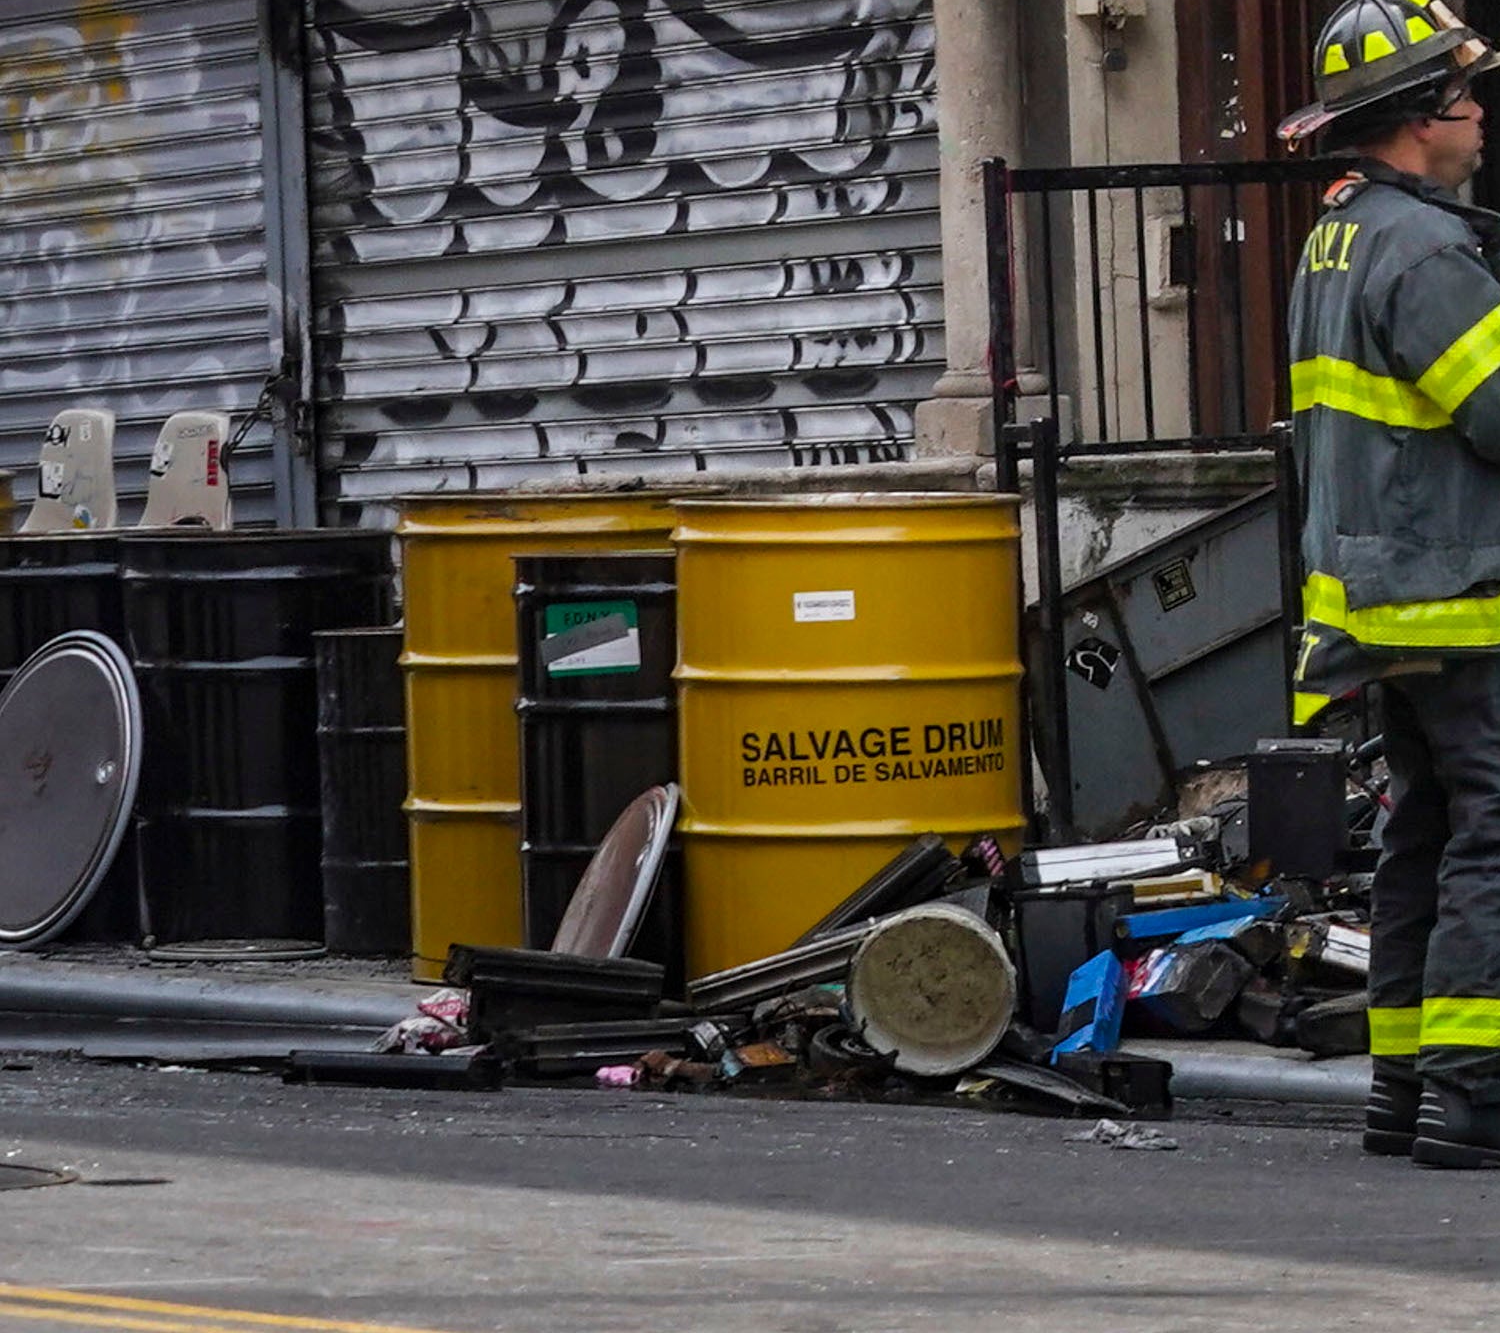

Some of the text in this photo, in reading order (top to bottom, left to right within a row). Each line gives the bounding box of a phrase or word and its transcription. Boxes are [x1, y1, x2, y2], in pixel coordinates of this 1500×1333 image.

[741, 717, 1004, 763] SALVAGE DRUM
[743, 752, 1005, 788] BARRIL DE SALVAMENTO
